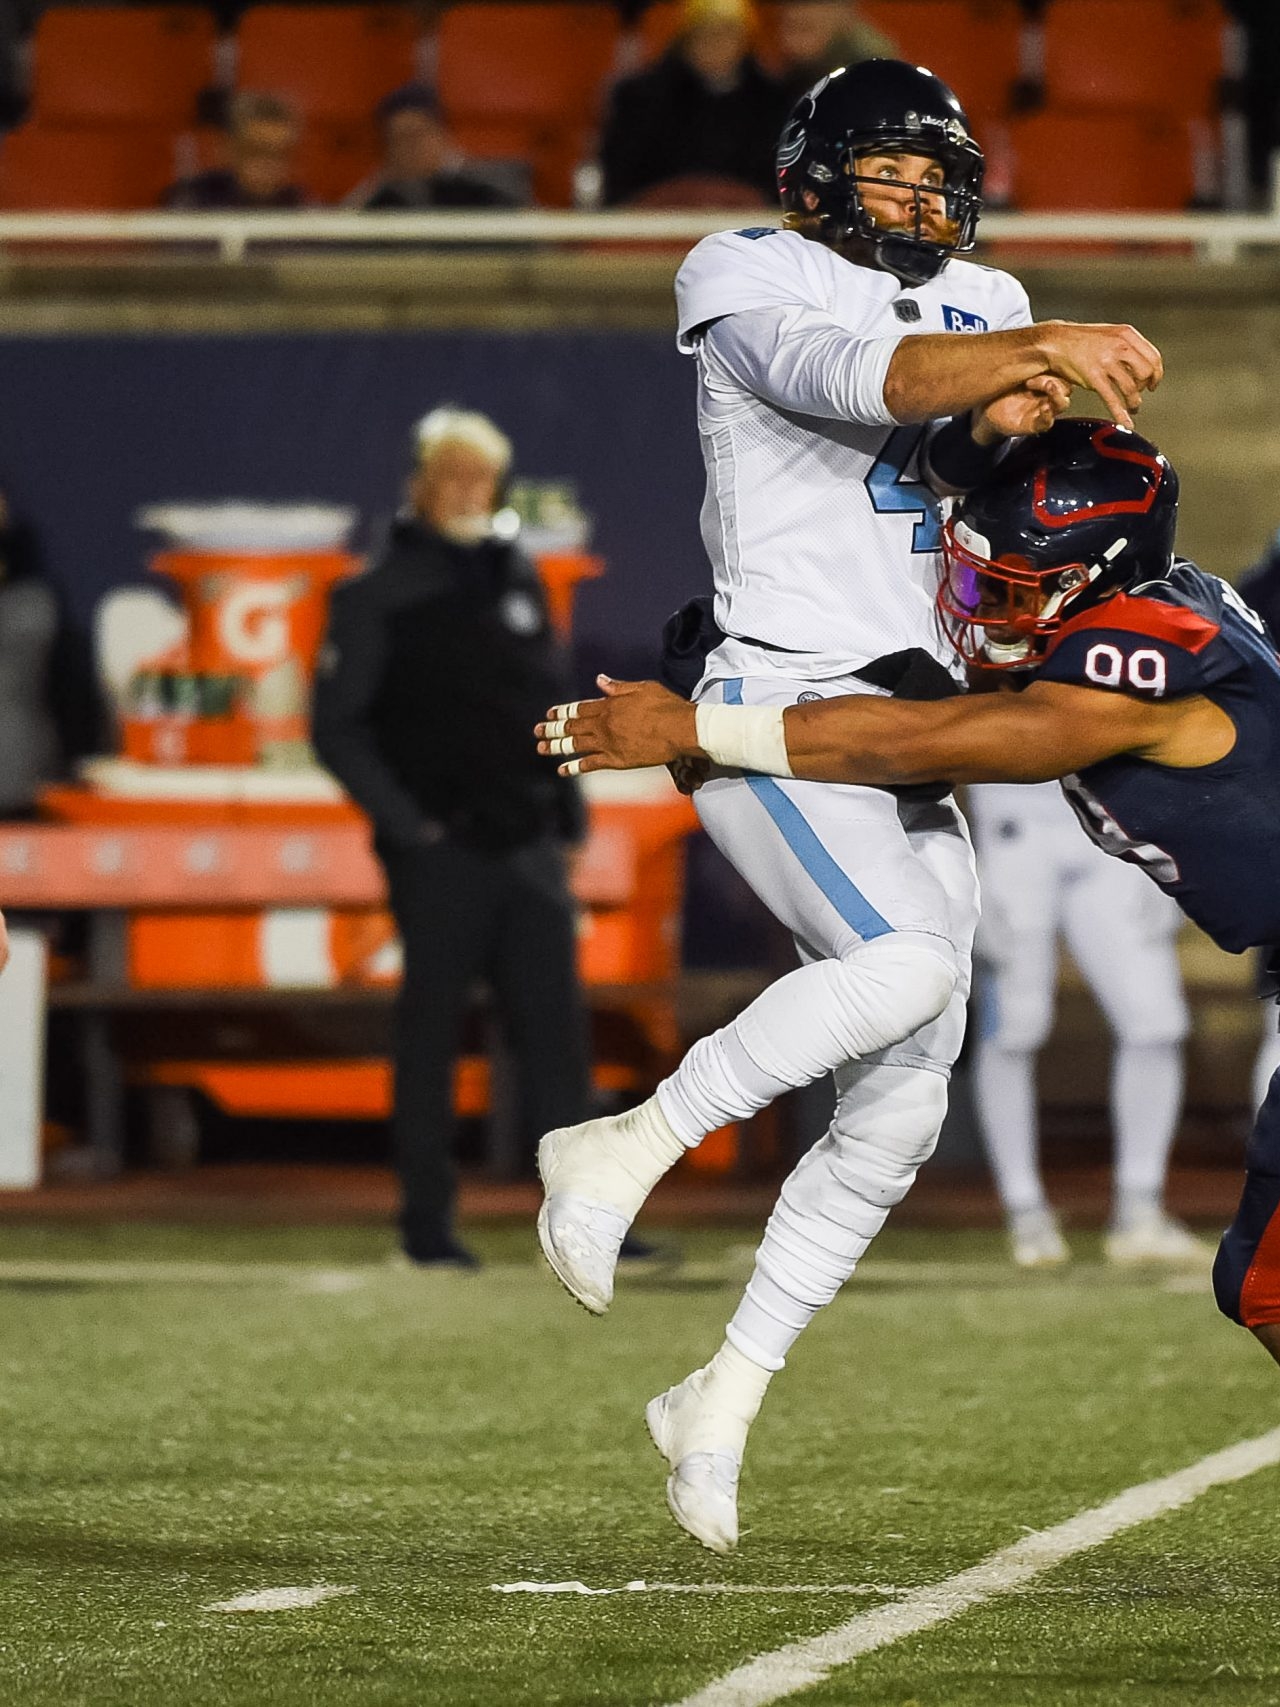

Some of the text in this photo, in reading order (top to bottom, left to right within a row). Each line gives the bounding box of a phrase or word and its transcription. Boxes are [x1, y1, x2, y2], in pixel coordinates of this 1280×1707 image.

[863, 424, 944, 554] 4
[223, 582, 284, 660] G
[1085, 643, 1166, 697] 99
